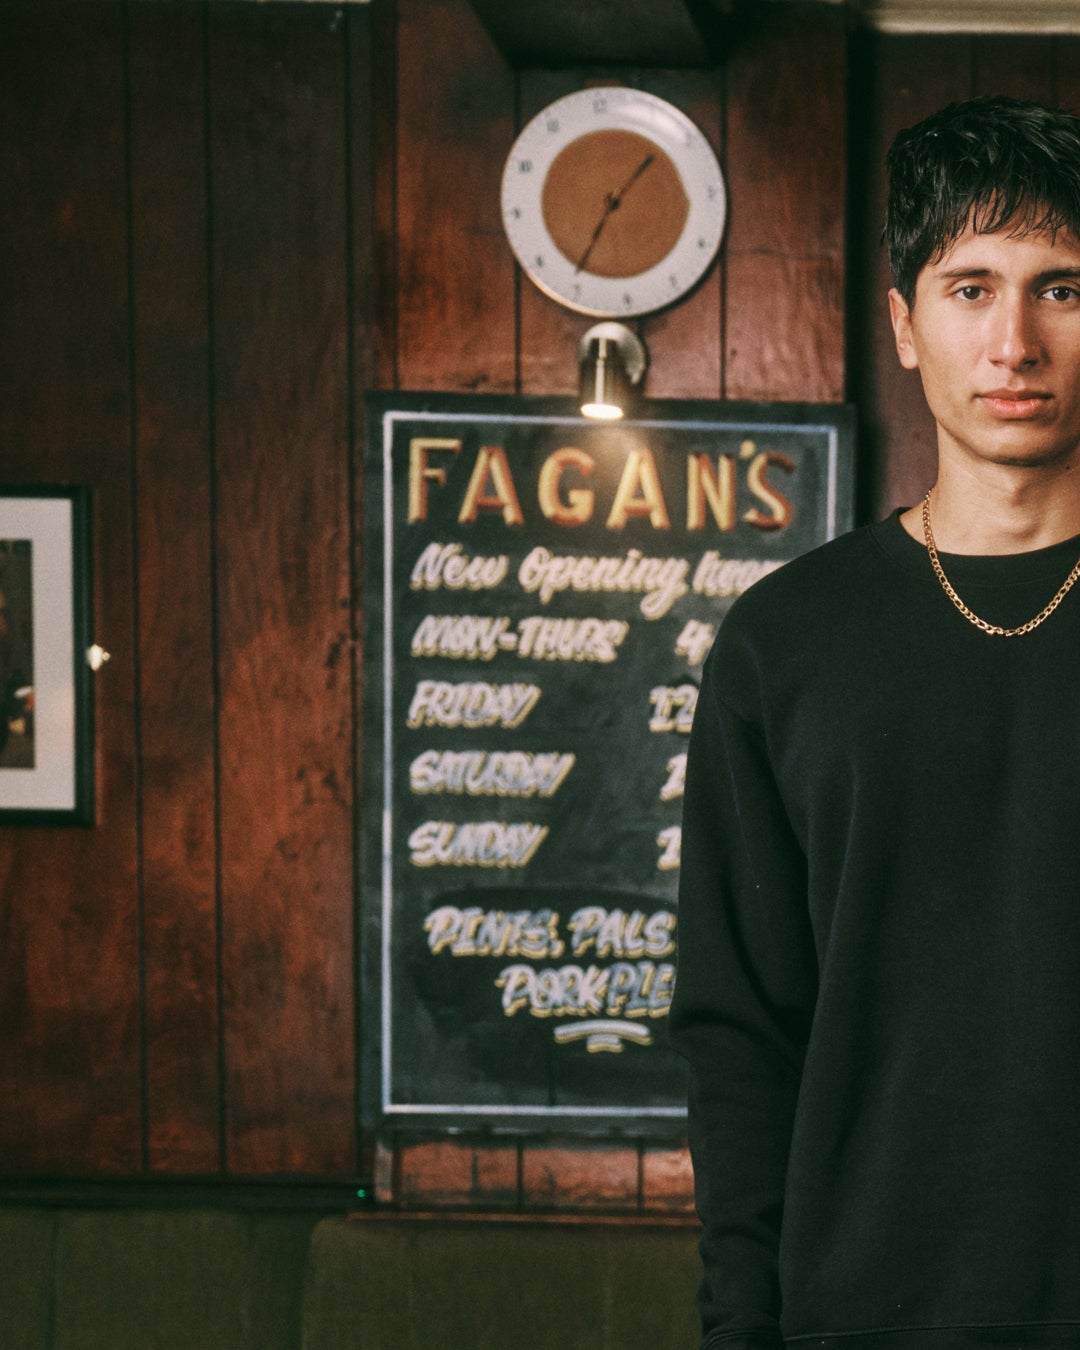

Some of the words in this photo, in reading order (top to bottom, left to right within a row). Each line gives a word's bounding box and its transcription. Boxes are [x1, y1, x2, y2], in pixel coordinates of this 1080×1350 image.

[407, 438, 796, 531] FAGAN'S
[409, 541, 509, 591] New
[518, 546, 690, 620] Opening
[406, 680, 542, 730] FRIDAY
[409, 750, 576, 798] SATURDAY
[407, 821, 550, 868] SUNDAY
[494, 963, 610, 1018] PORK
